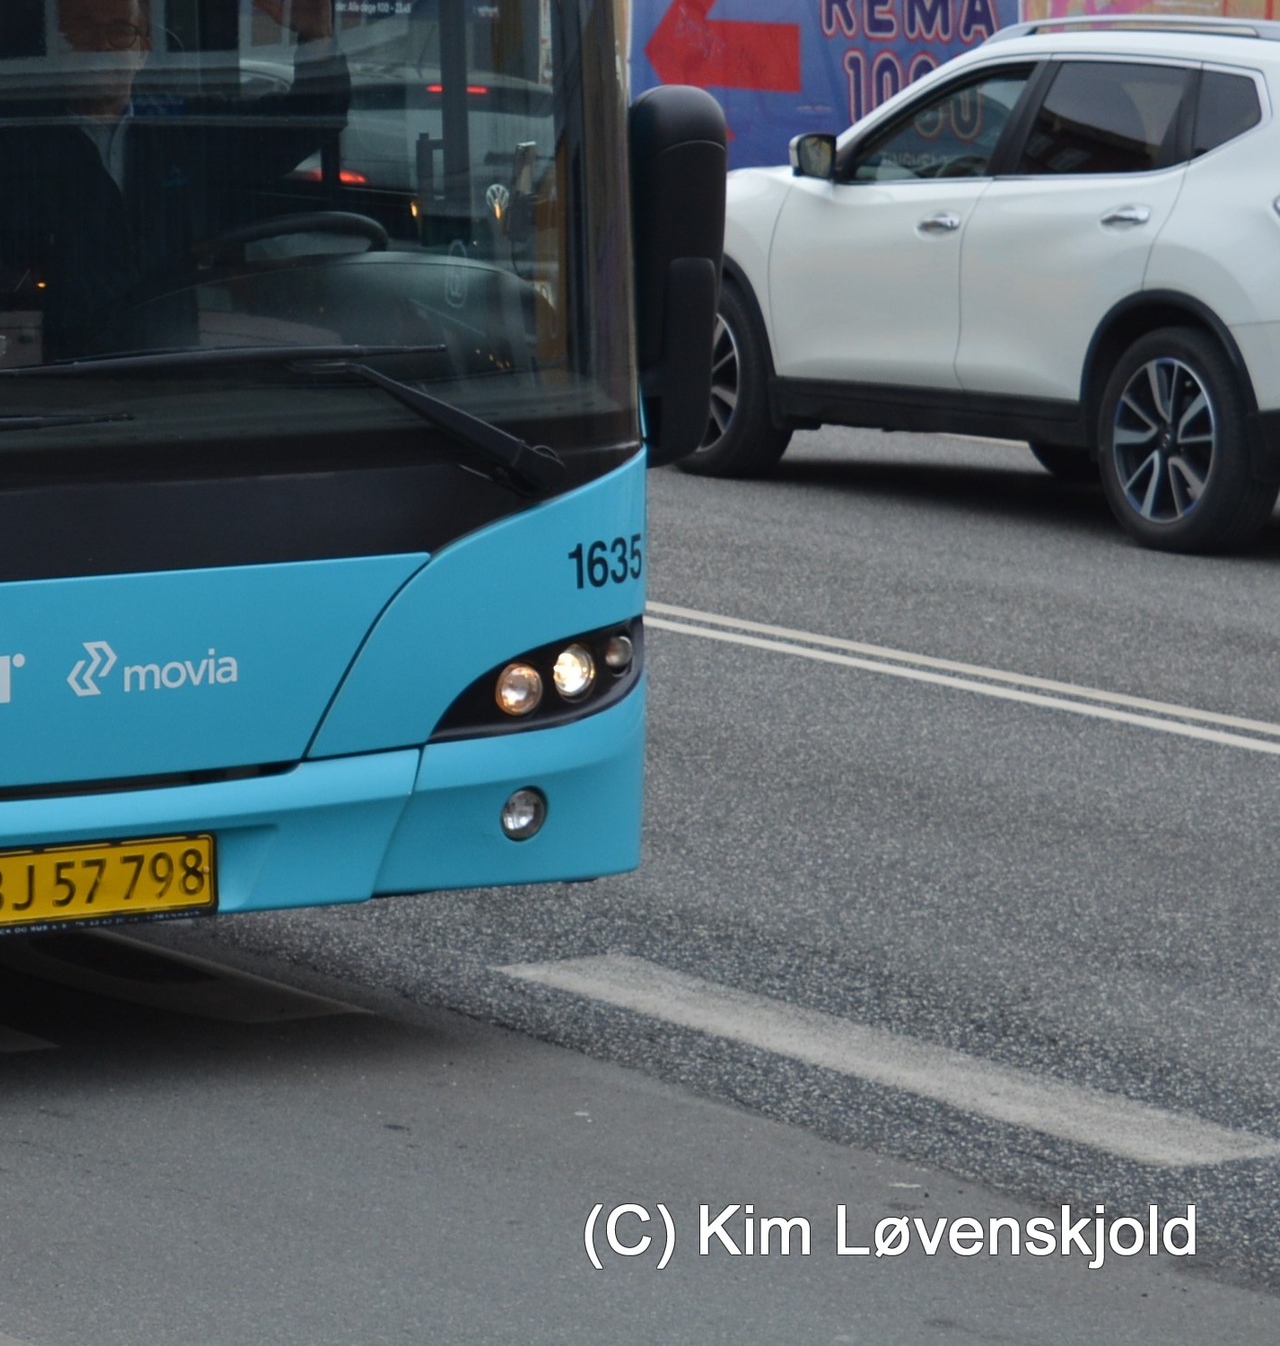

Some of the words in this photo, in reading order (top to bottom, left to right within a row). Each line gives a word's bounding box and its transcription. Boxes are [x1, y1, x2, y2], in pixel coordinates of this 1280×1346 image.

[568, 533, 643, 590] 1635
[123, 647, 238, 693] movia
[52, 858, 107, 908] 57
[120, 848, 205, 901] 798
